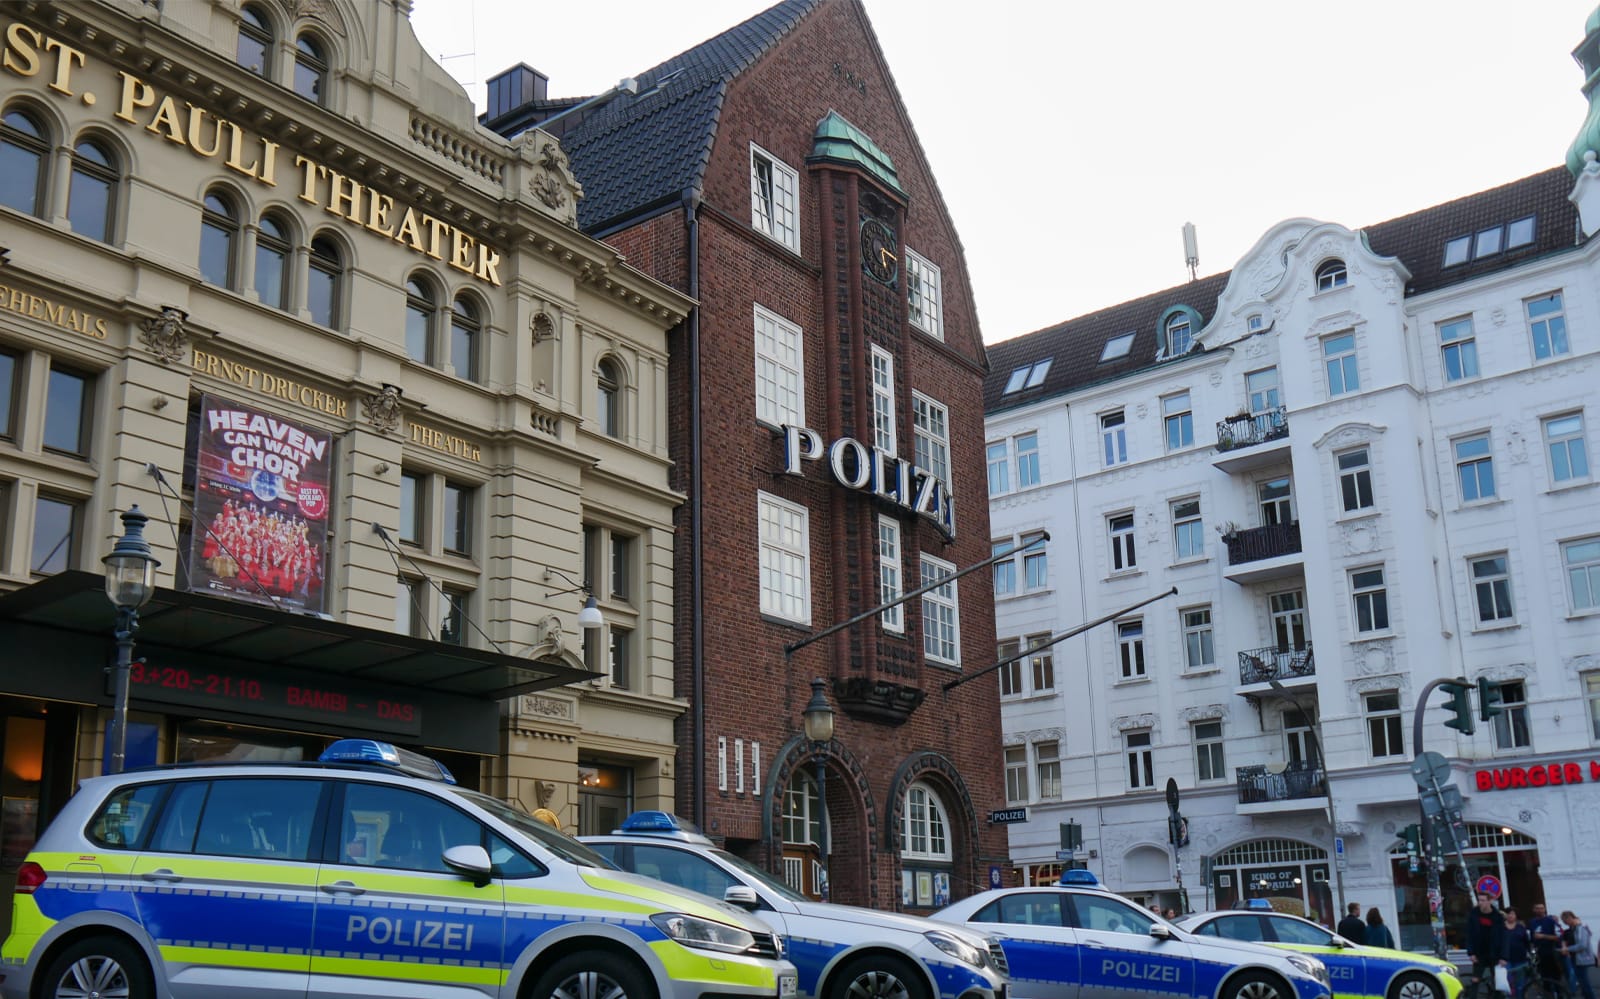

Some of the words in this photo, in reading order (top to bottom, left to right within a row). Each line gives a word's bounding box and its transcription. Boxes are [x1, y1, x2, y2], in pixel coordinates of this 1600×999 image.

[3, 23, 97, 106] ST.
[114, 70, 280, 187] PAULI
[295, 155, 502, 287] THEATER
[0, 285, 107, 340] EHEMALS
[192, 349, 259, 389] ERNST
[261, 371, 347, 418] DRUCKER
[208, 410, 327, 461] HEAVEN
[223, 431, 261, 449] CAN
[264, 436, 310, 469] WAIT
[408, 422, 481, 463] THEATER
[231, 446, 300, 483] CHOR
[781, 424, 956, 539] POLIZEI
[287, 686, 348, 713] BAMBI
[377, 700, 414, 722] DAS
[1475, 762, 1584, 792] BURGER
[993, 810, 1025, 821] POLIZEI
[1251, 872, 1277, 881] KING
[1278, 871, 1293, 880] OF
[346, 914, 475, 952] POLIZEI
[1102, 960, 1180, 984] POLIZEI
